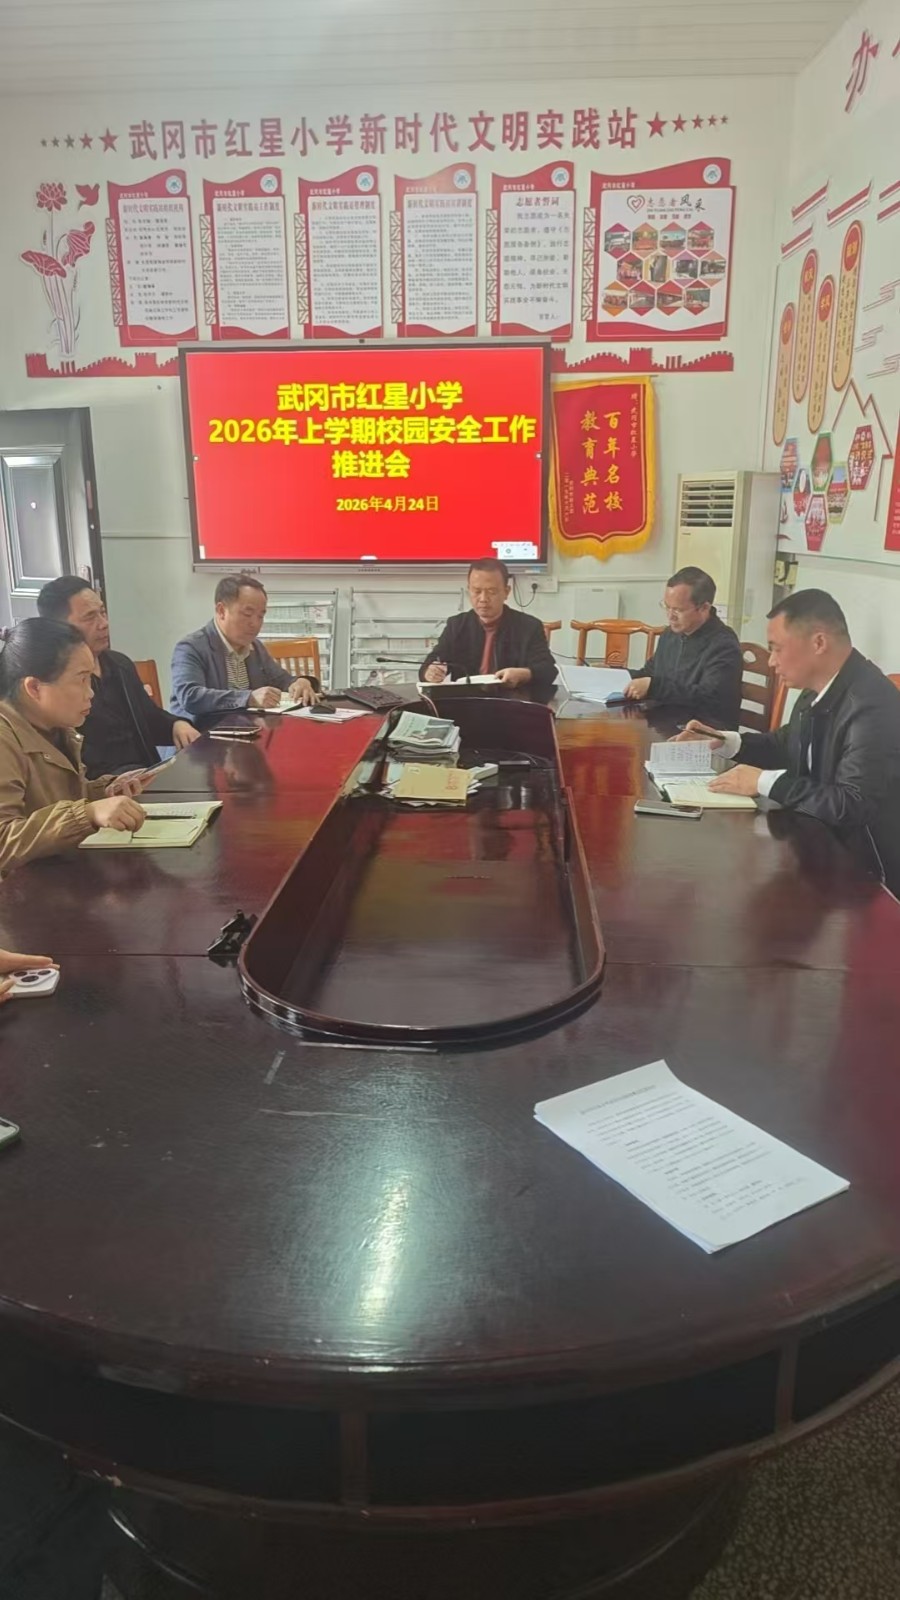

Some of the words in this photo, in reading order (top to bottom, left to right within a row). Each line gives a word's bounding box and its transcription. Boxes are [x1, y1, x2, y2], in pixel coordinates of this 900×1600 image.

[128, 107, 638, 160] 武冈市红星小学新时代文明实践站
[276, 381, 463, 411] 武冈市红星小学
[208, 414, 537, 445] 2026年上学期校园安全工作
[331, 450, 411, 478] 推进会
[580, 410, 600, 514] 教育典范
[603, 411, 623, 511] 百年名校
[336, 496, 439, 512] 2026年4月24日
